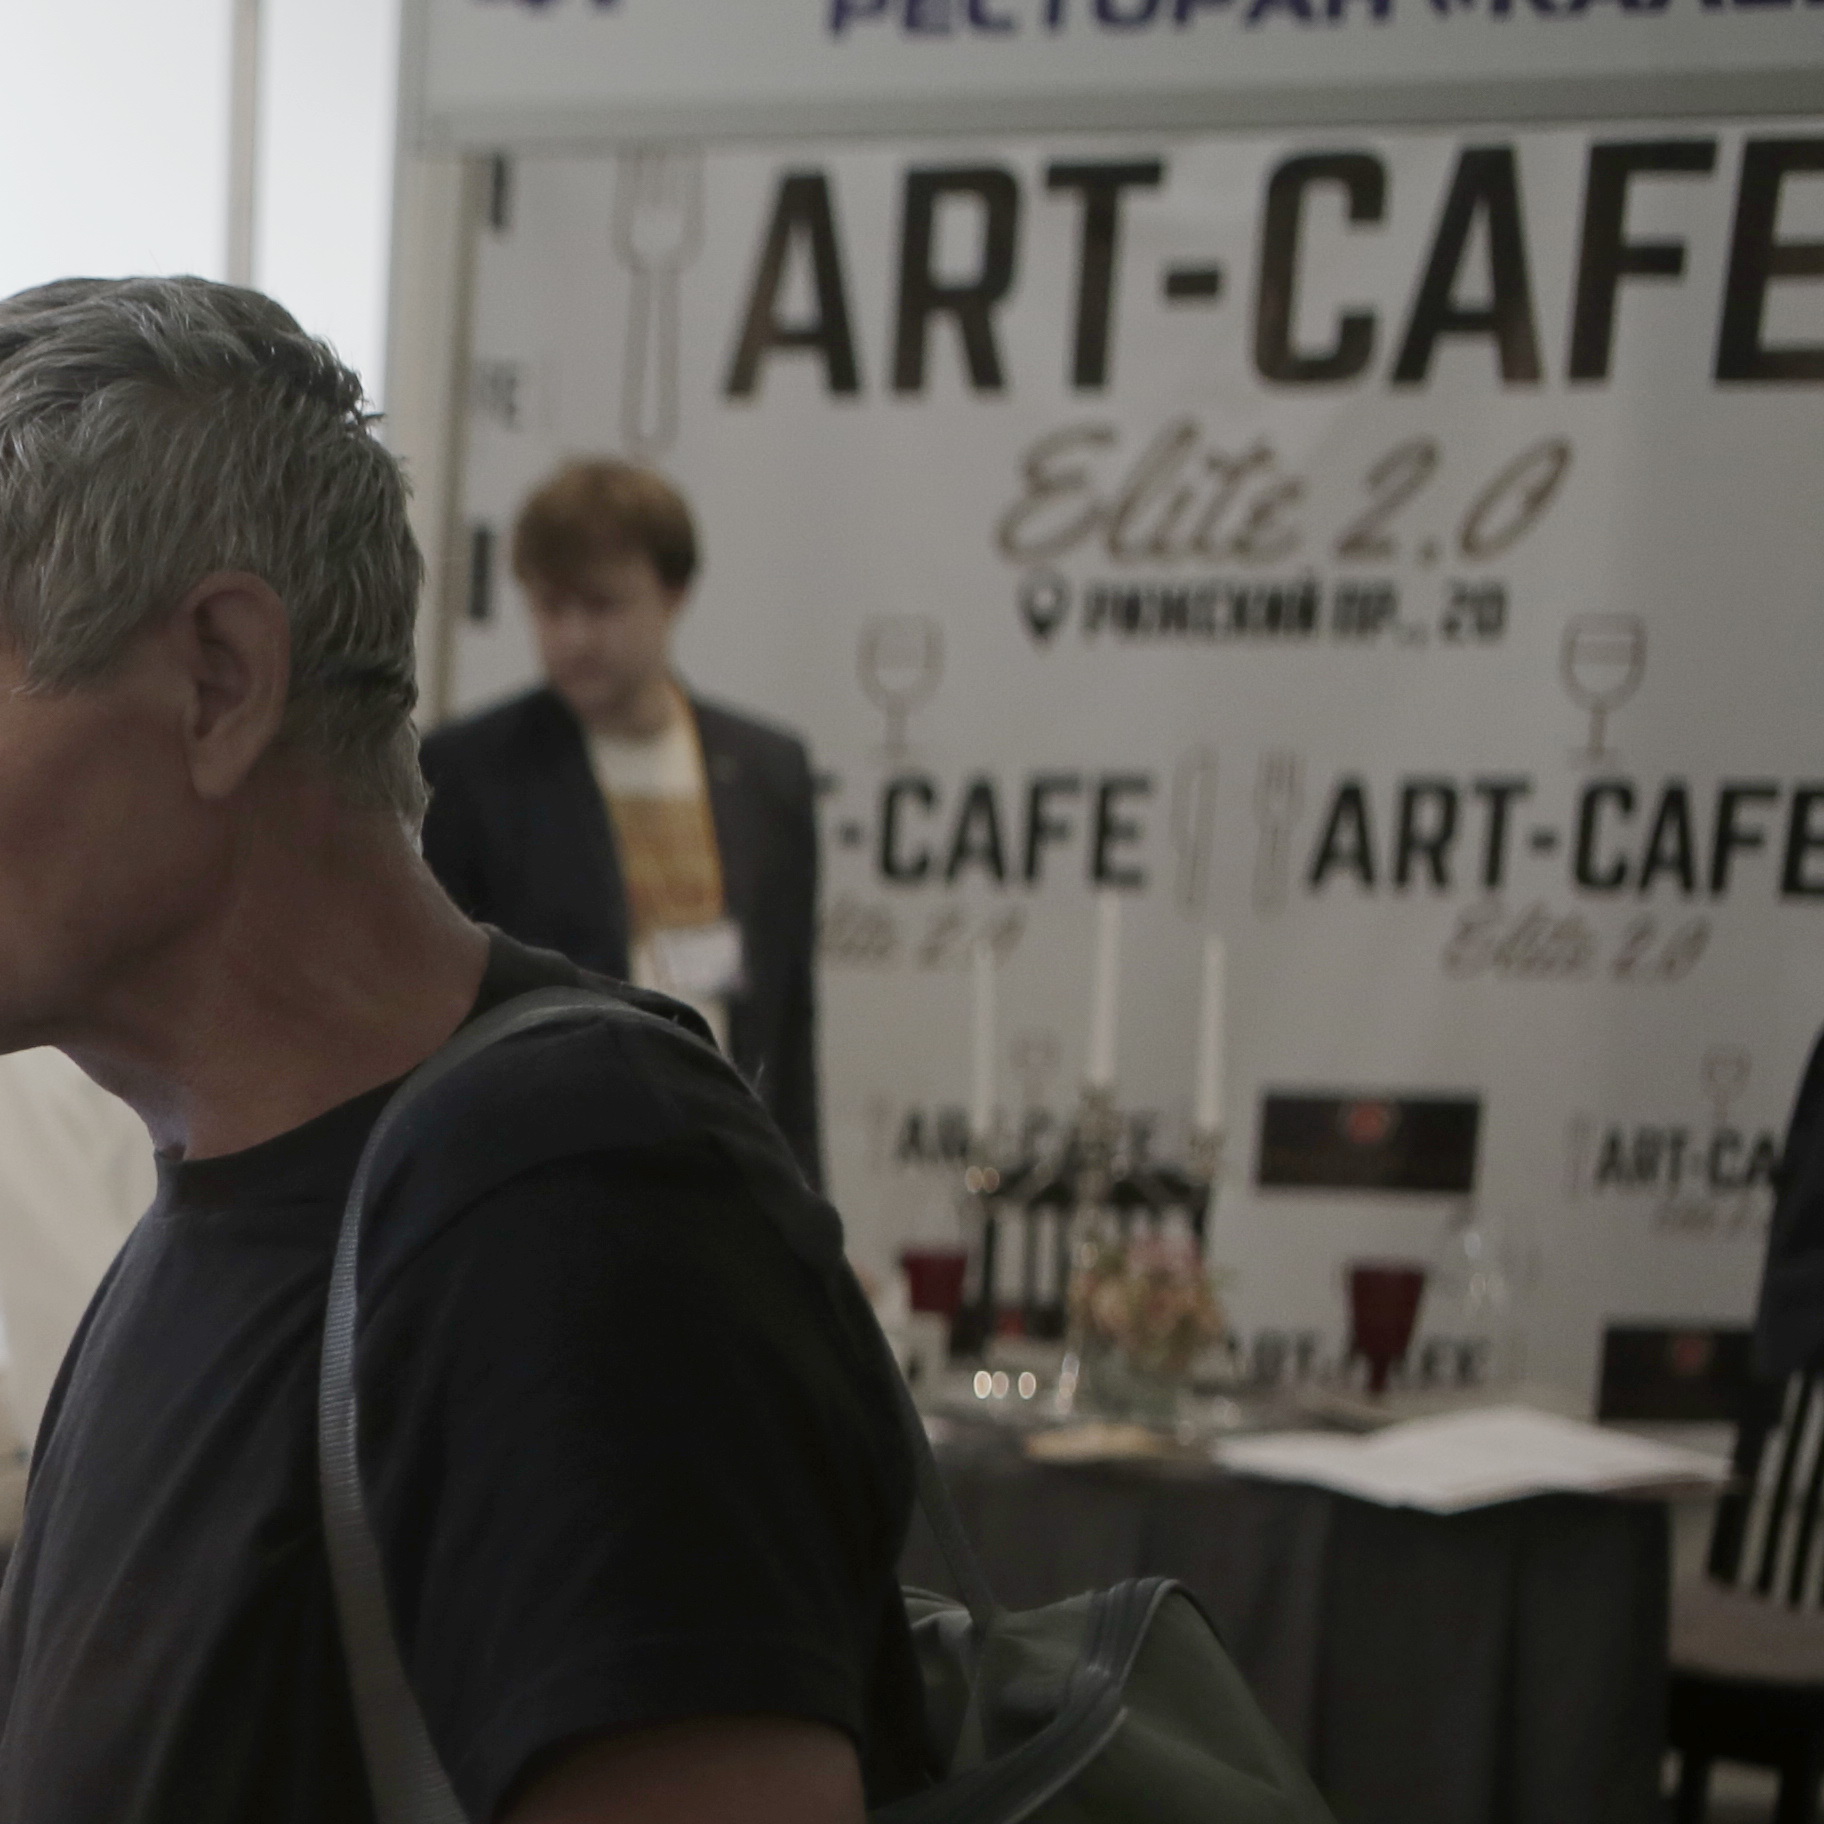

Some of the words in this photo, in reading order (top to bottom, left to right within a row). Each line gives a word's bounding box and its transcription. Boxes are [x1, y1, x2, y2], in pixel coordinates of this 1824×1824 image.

[724, 135, 1824, 400] ART-CAFE
[995, 419, 1307, 564] Elite
[1335, 434, 1574, 567] 2.0
[814, 769, 1151, 886] -CAFE
[1307, 776, 1824, 901] ART-CAFE
